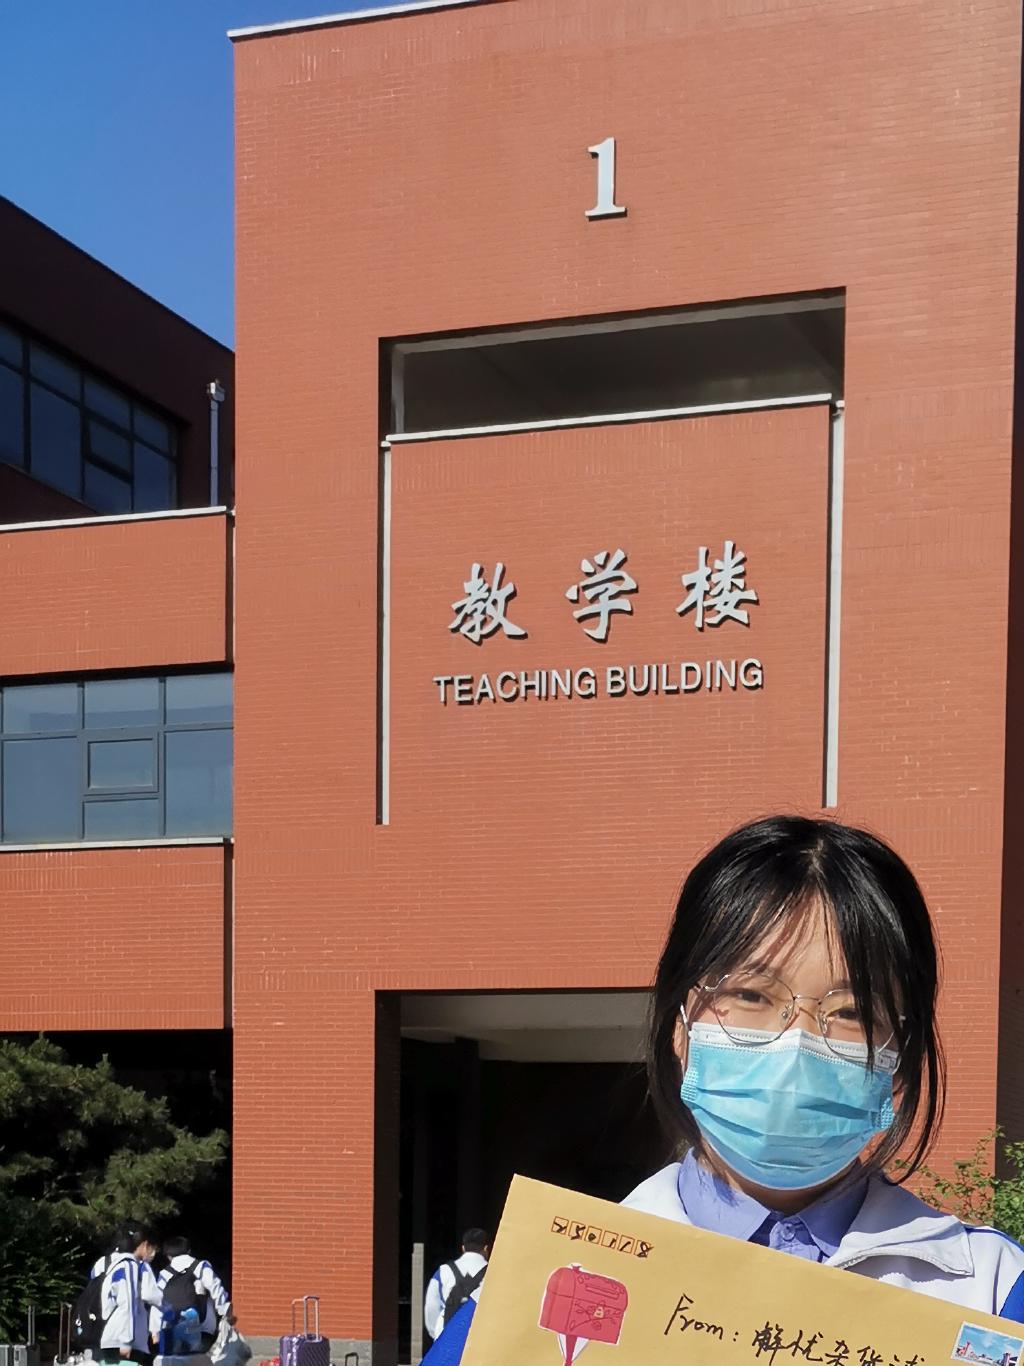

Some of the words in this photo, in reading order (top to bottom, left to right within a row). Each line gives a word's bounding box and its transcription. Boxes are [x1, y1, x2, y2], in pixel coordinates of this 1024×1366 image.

[585, 136, 627, 221] 1
[447, 540, 760, 643] 教学楼
[433, 668, 597, 704] TEACHING
[606, 658, 764, 696] BUILDING
